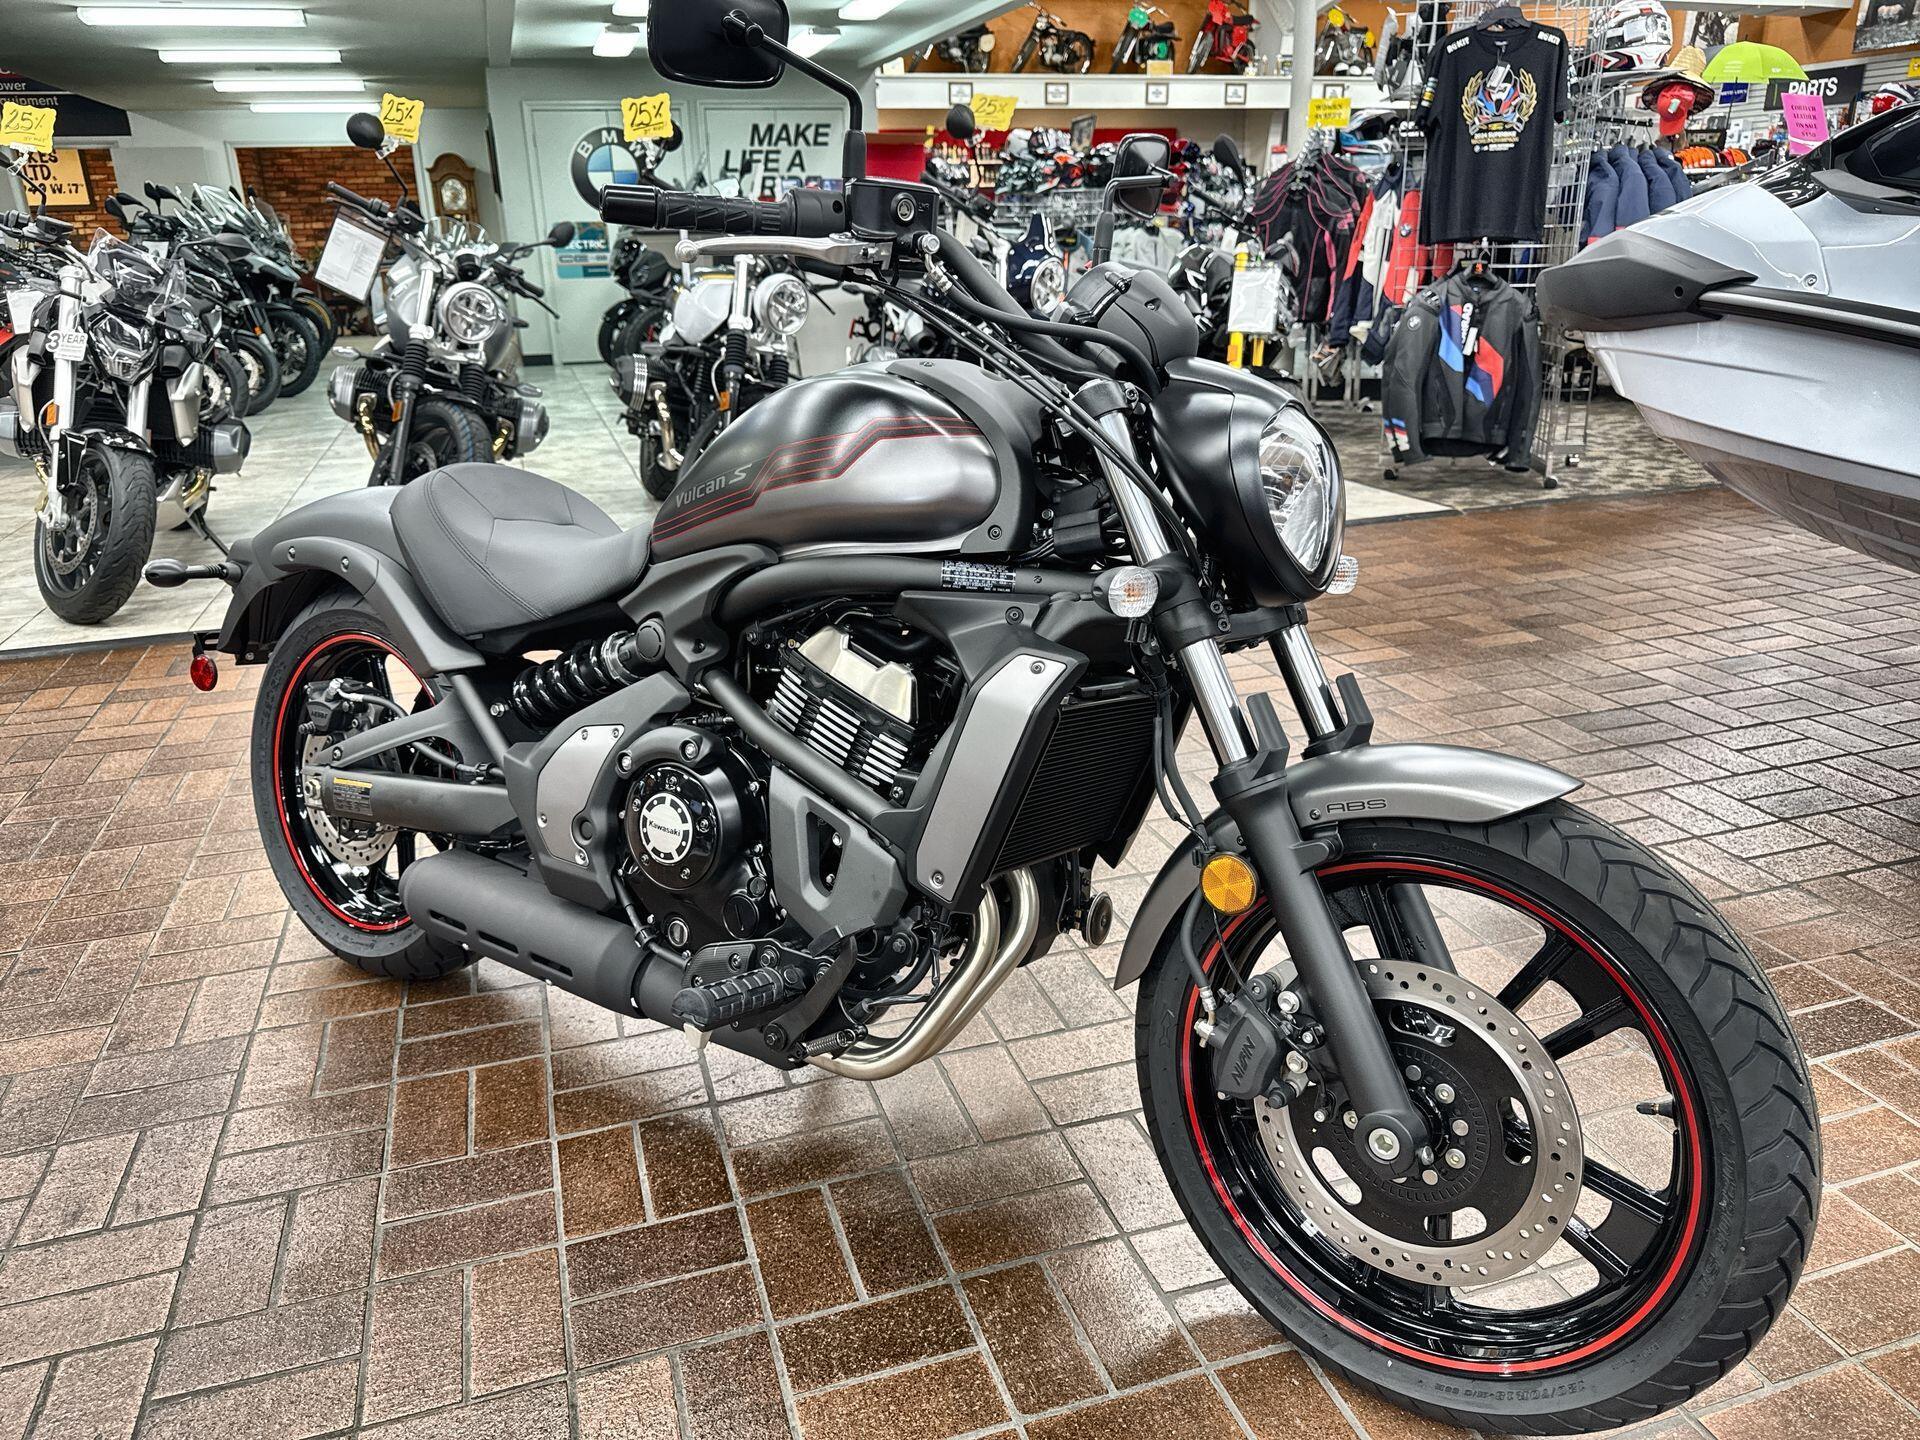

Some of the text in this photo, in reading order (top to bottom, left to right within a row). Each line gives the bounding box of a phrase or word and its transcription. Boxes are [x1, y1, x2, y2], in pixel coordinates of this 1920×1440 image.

[0, 82, 26, 91] ower
[1788, 76, 1838, 97] PARTS
[0, 95, 59, 106] quipment
[383, 99, 415, 123] 25%
[4, 108, 46, 131] 25%
[629, 101, 664, 128] 25%
[750, 123, 831, 147] MAKE
[724, 149, 805, 173] LIFE A
[61, 333, 85, 344] YEAR
[675, 463, 752, 508] Vulcan S
[1326, 798, 1387, 813] ABS
[648, 820, 681, 837] Kawasaki
